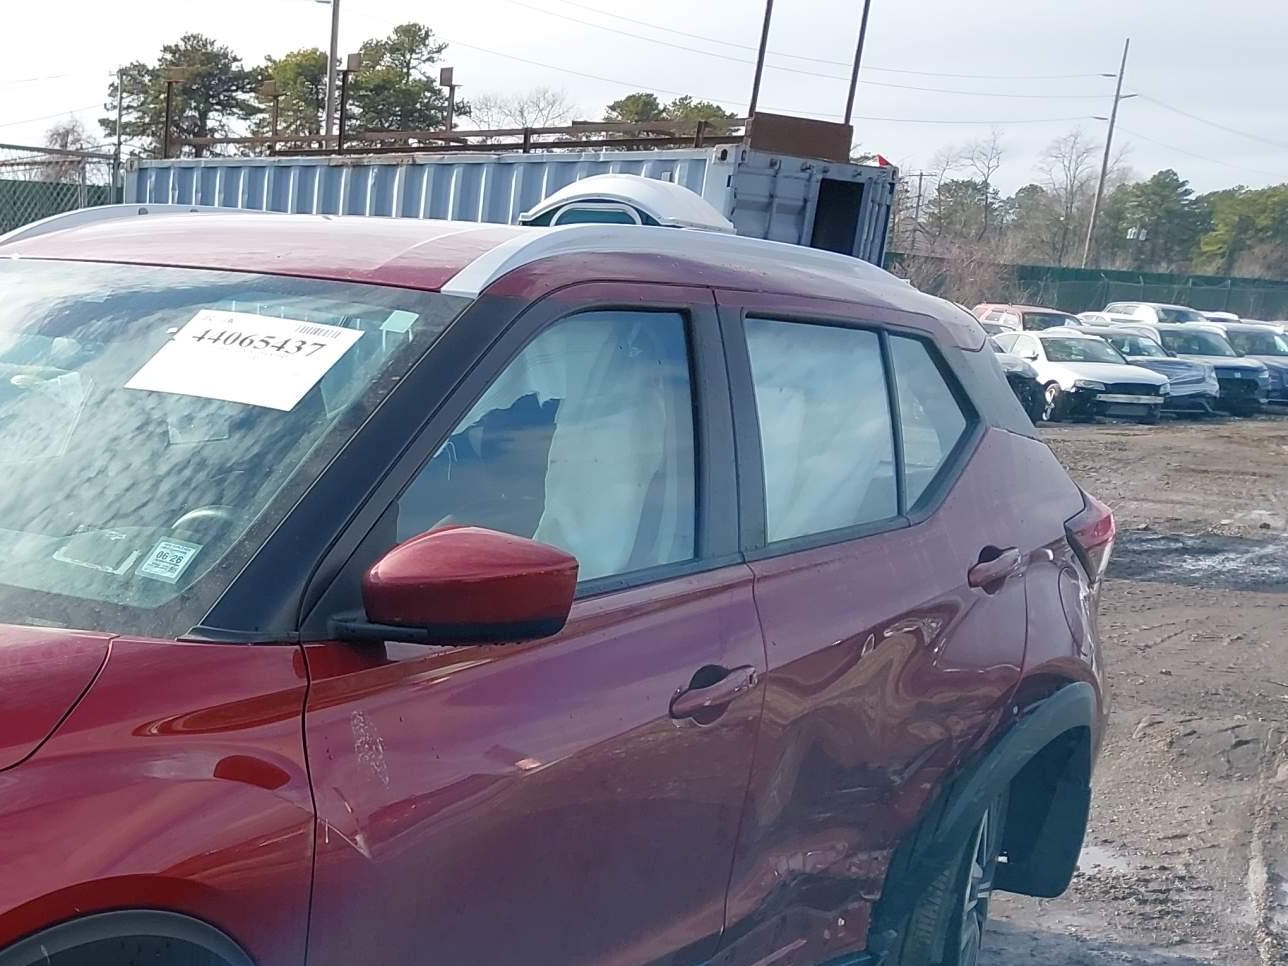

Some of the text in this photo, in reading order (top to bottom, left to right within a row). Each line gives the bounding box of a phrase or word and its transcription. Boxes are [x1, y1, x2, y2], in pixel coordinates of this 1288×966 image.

[191, 328, 327, 357] 44065437
[157, 550, 184, 565] 06 26
